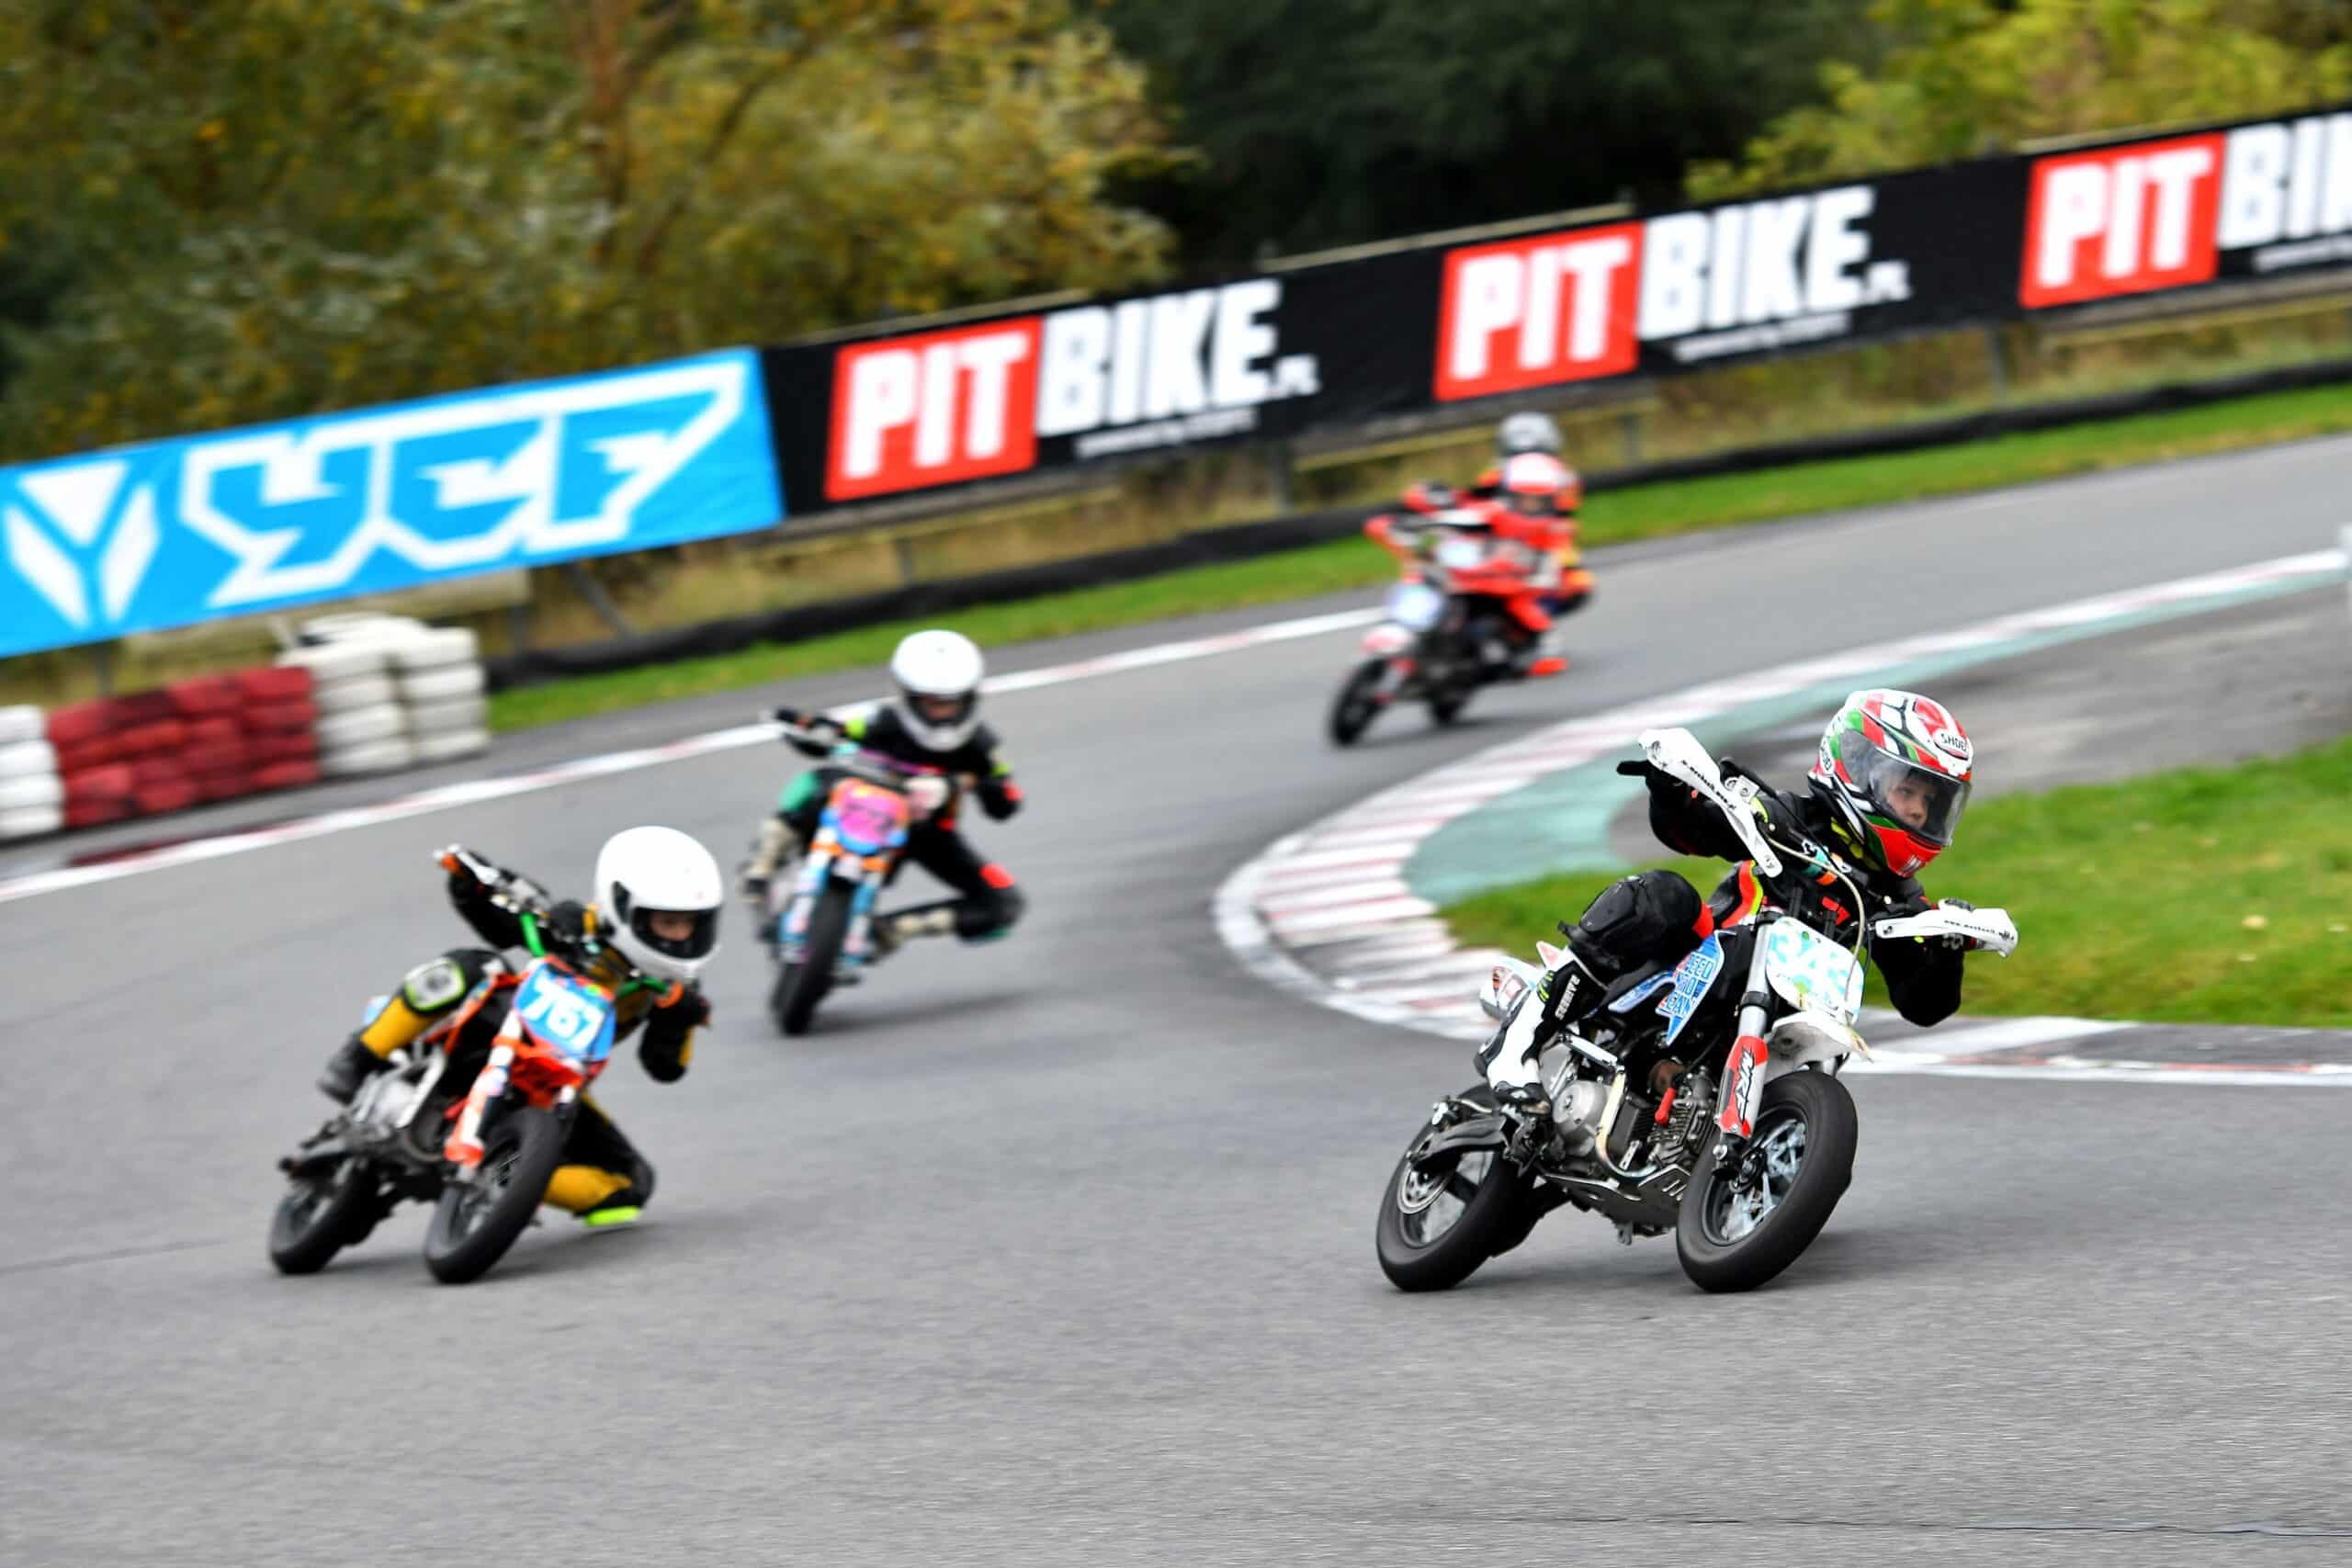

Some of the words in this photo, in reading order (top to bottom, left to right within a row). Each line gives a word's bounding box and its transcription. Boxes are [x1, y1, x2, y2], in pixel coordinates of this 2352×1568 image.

[2037, 146, 2214, 289] PIT
[1449, 236, 1633, 382] PIT
[841, 330, 1031, 479] PIT
[177, 360, 747, 608] YCF
[1939, 732, 1968, 752] SHOE
[521, 973, 606, 1052] 767
